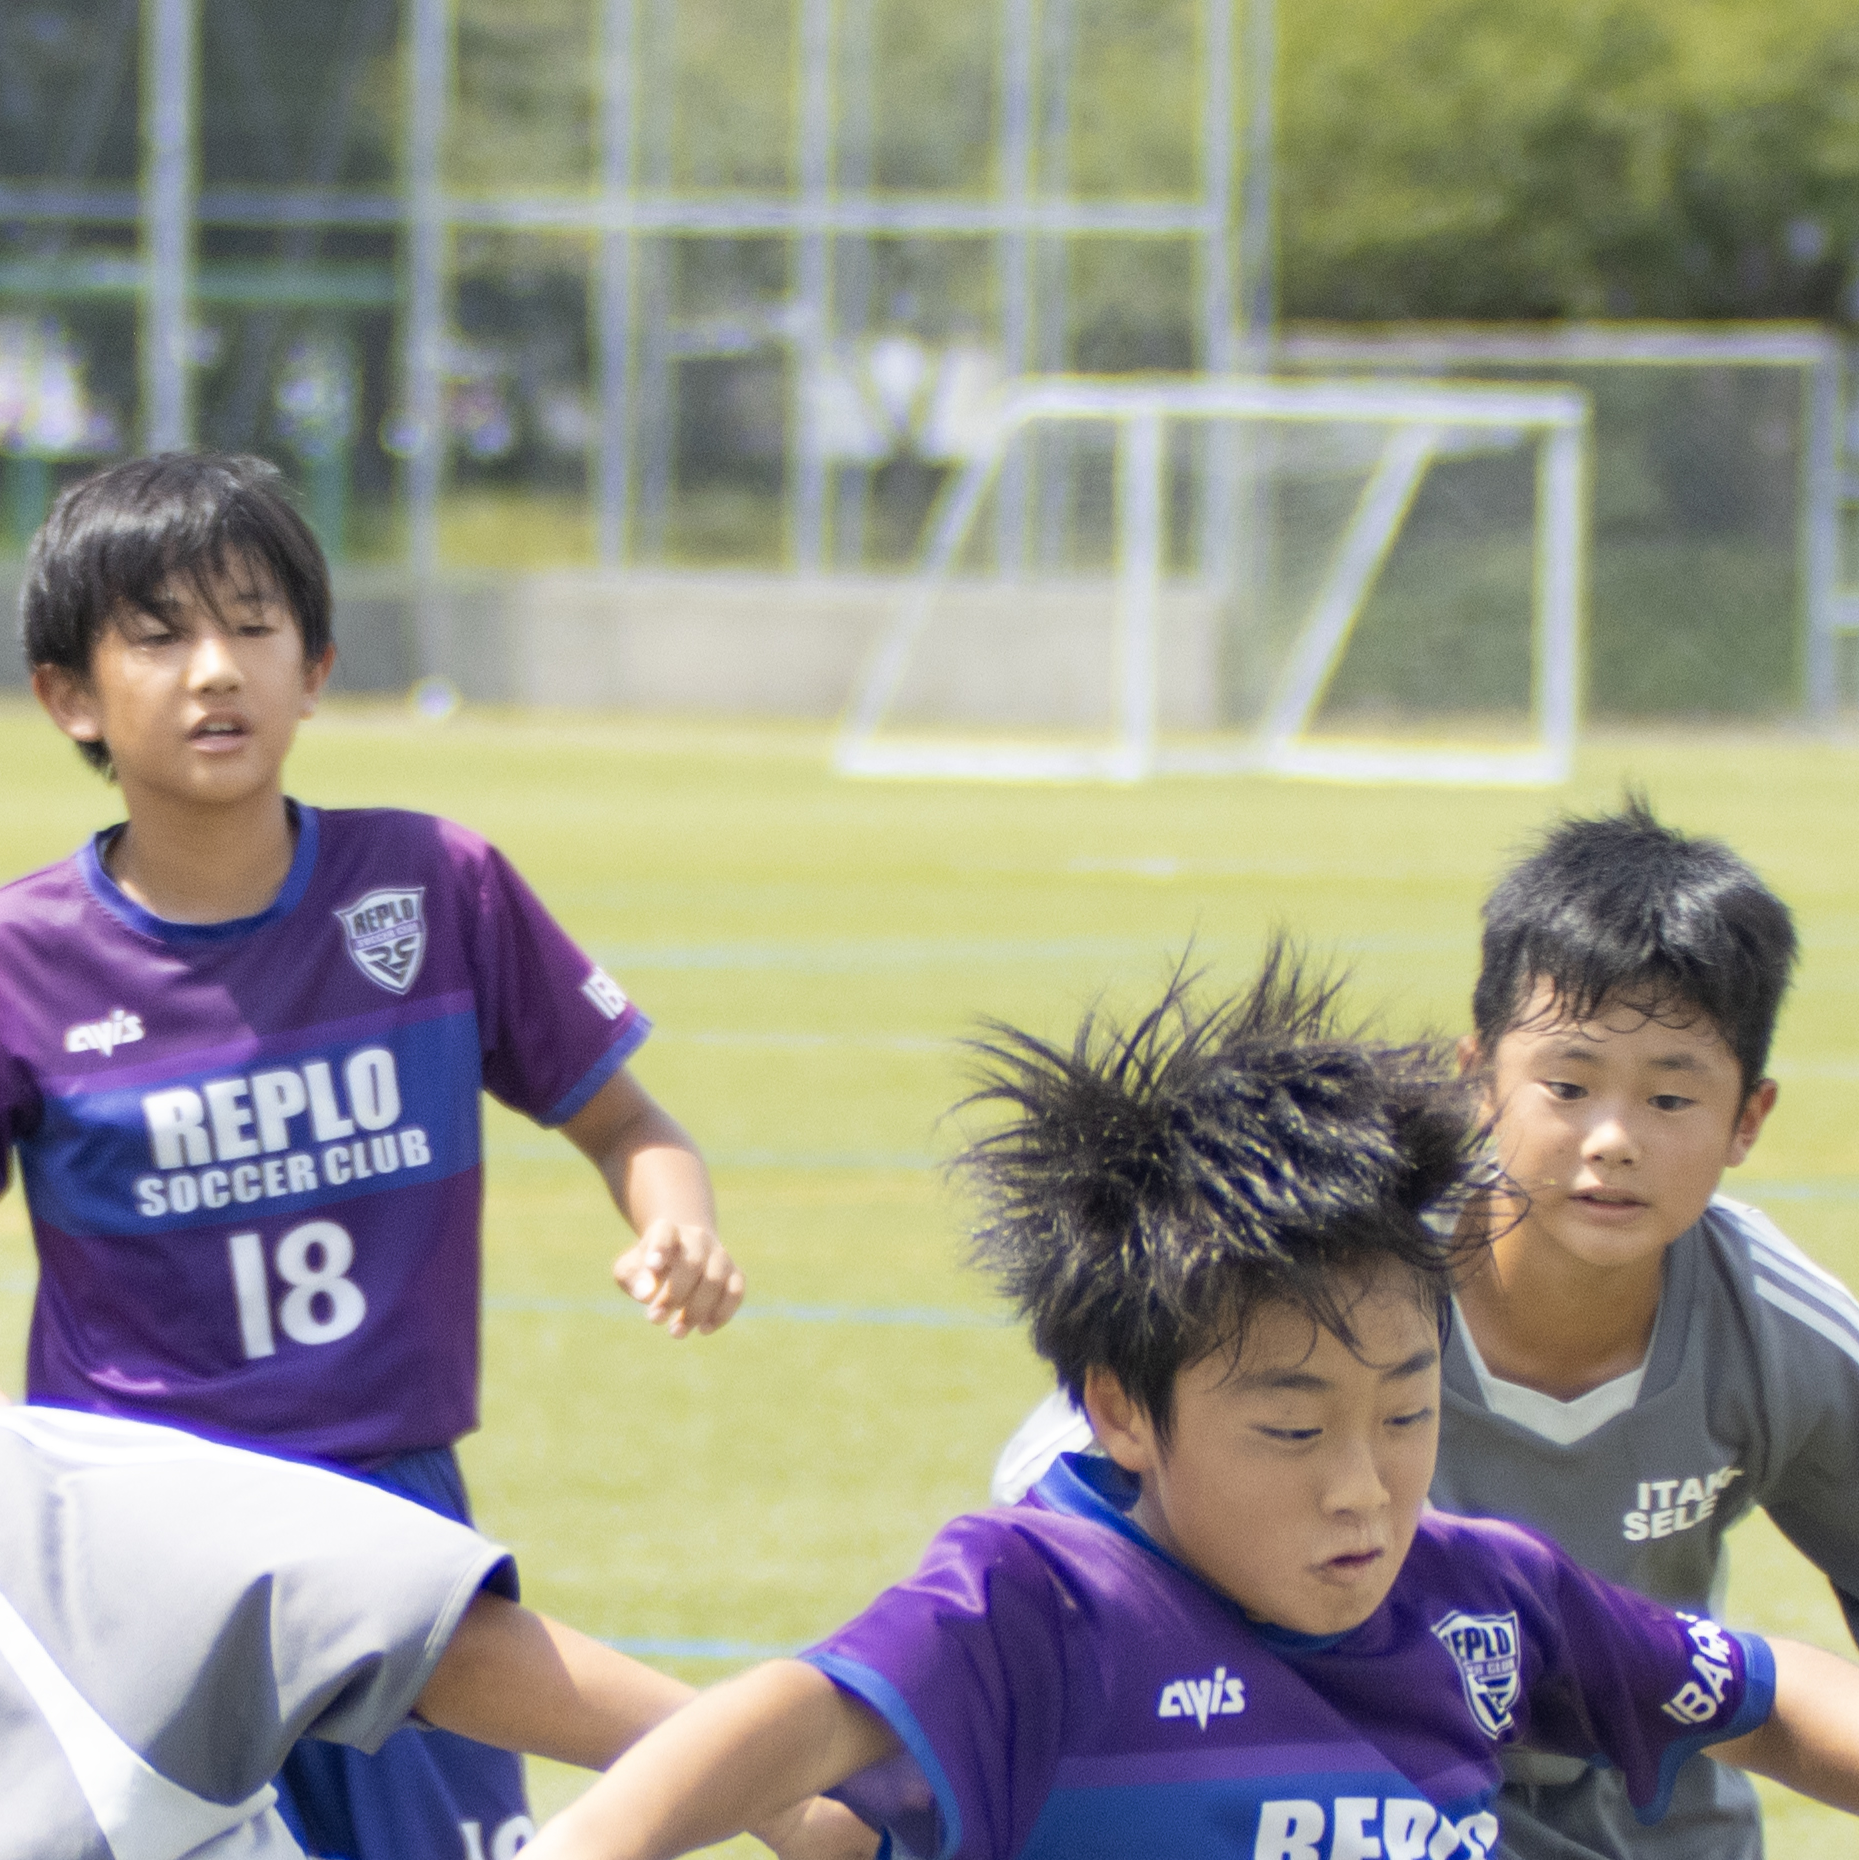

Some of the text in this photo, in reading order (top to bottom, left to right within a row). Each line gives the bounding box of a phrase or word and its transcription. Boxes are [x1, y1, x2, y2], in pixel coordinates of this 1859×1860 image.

[144, 1048, 402, 1170] REPLO
[136, 1128, 431, 1217] SOCCER CLUB
[229, 1220, 367, 1360] 18
